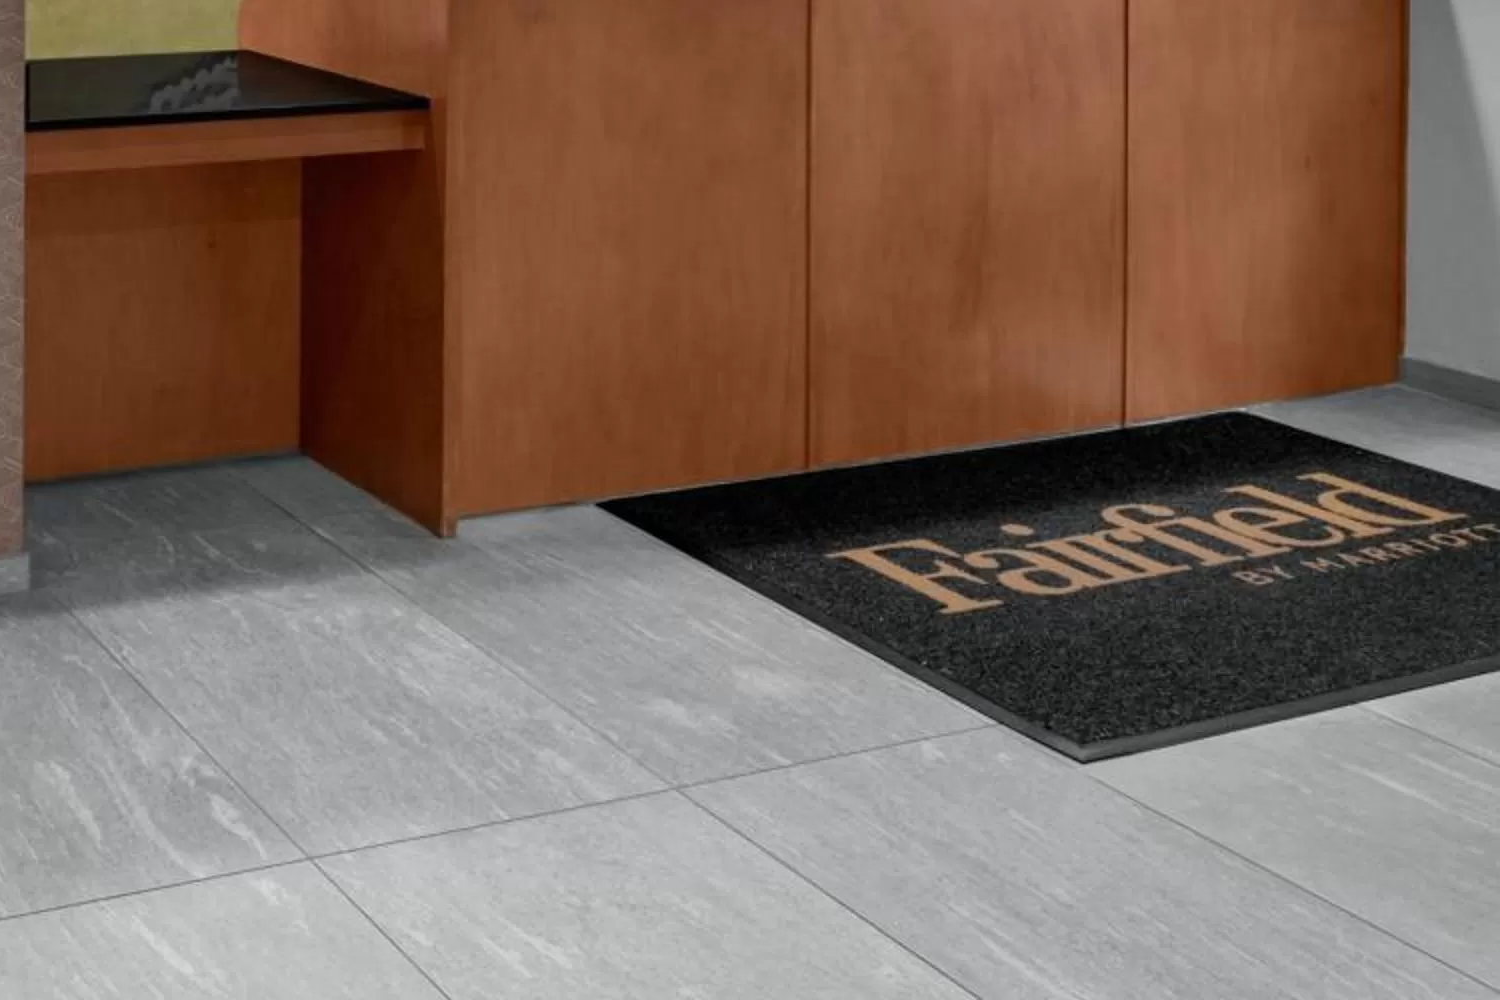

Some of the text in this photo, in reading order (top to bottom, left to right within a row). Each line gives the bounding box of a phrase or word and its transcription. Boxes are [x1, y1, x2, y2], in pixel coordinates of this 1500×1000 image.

[826, 472, 1468, 616] Fairfield
[1232, 523, 1500, 586] BY MARRIOTT
